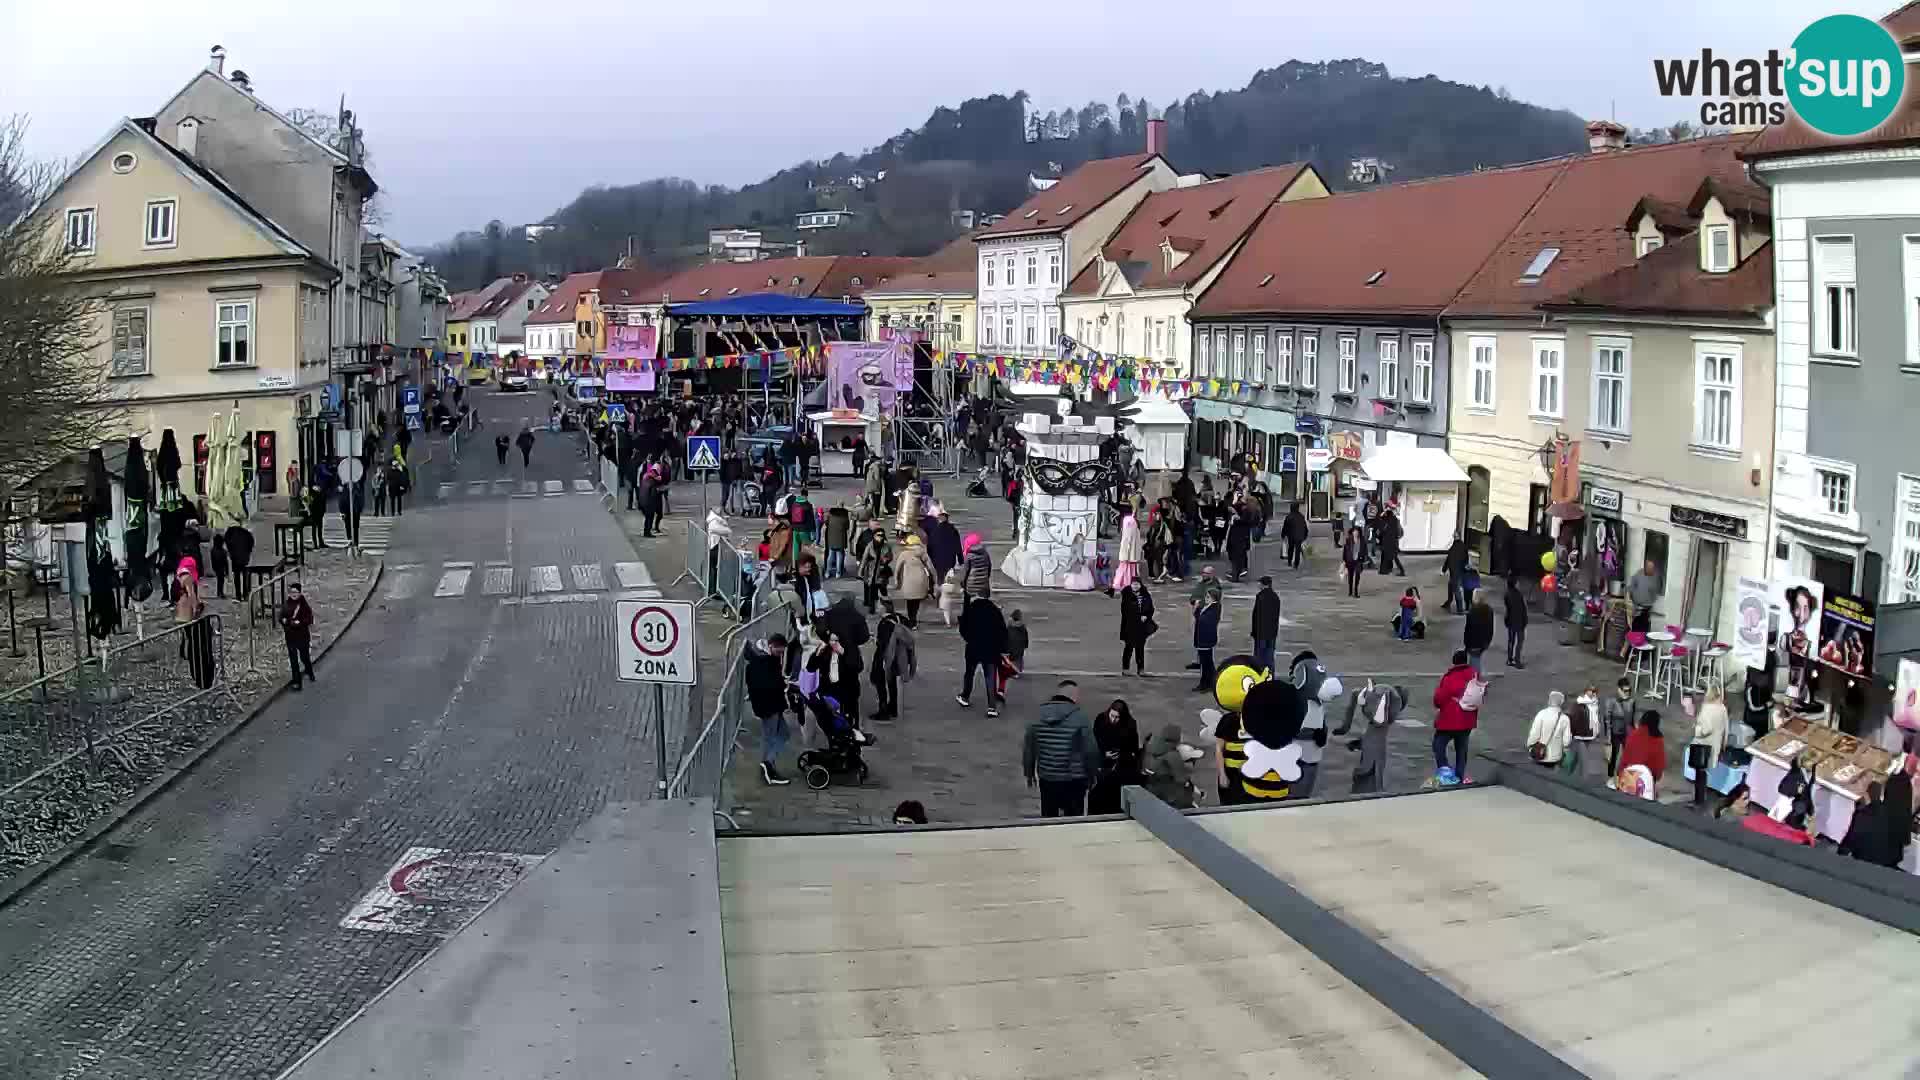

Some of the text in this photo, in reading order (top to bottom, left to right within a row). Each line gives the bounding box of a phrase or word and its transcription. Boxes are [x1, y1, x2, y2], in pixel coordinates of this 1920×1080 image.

[407, 391, 416, 402] P
[643, 622, 667, 643] 30
[633, 659, 678, 677] ZONA
